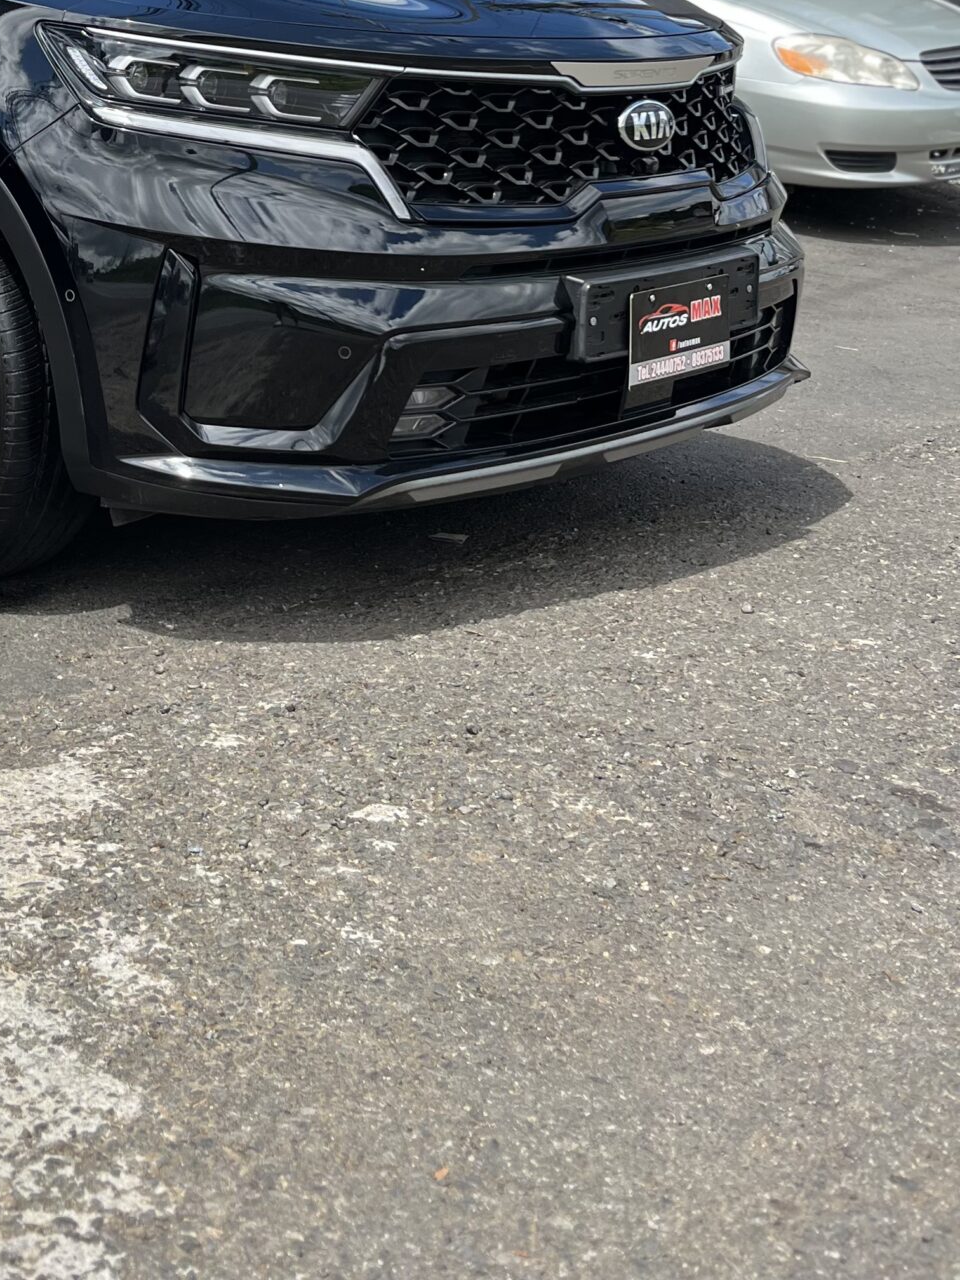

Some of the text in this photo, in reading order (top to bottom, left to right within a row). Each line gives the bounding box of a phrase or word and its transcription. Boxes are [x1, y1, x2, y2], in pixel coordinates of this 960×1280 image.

[631, 110, 670, 140] KIA
[642, 295, 722, 333] AUTOS MAX
